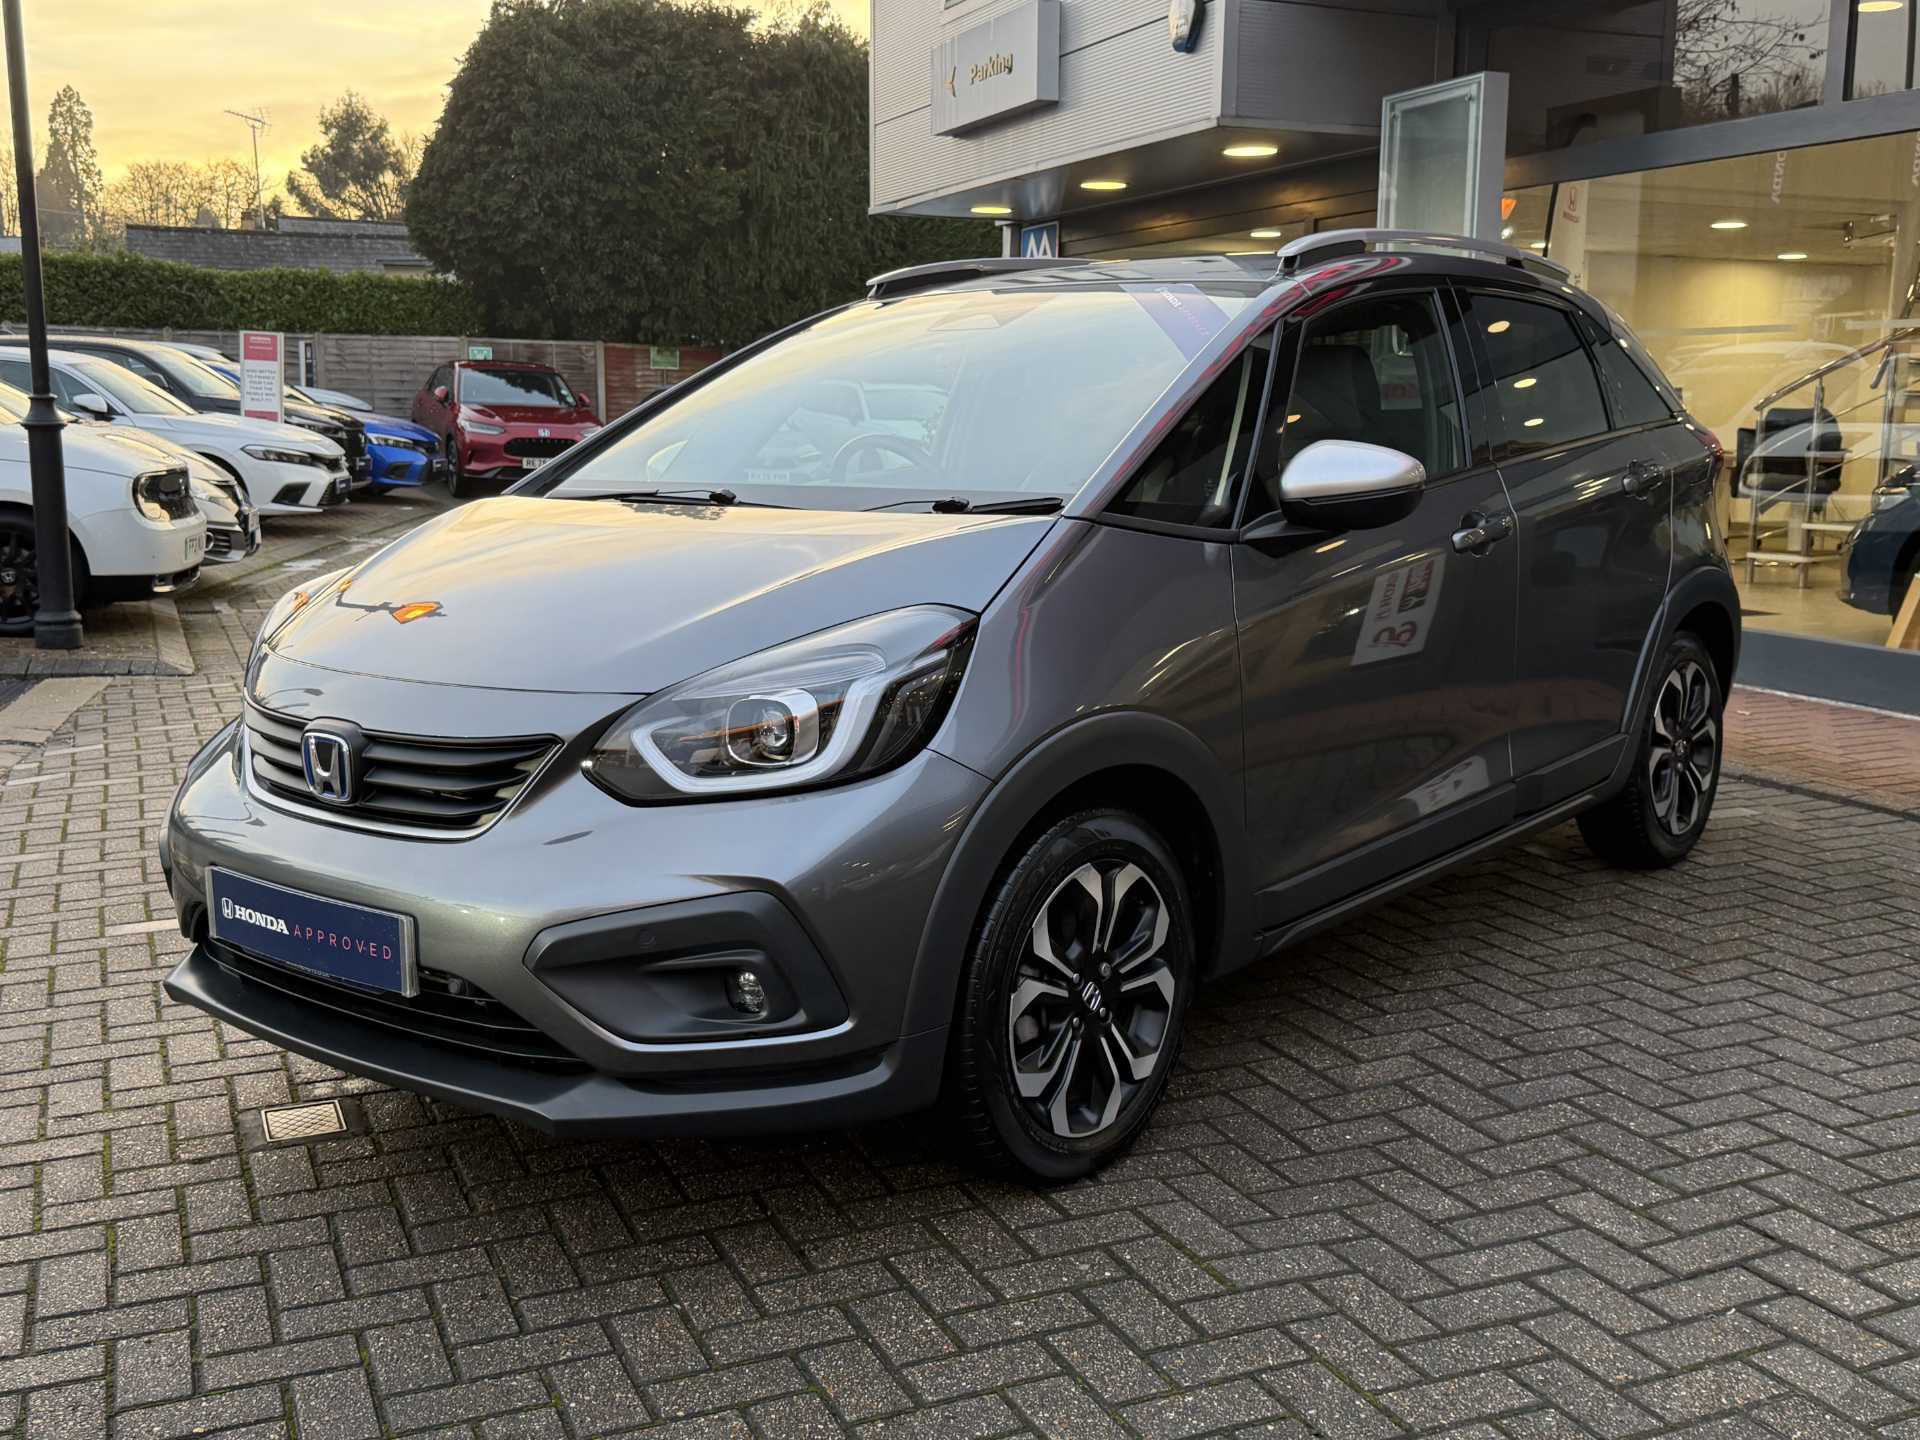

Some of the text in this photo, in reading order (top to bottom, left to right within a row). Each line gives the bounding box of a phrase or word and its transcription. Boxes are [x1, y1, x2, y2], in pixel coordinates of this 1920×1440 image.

[968, 53, 1014, 85] Parking
[234, 904, 290, 935] HONDA
[294, 924, 392, 960] APPROVED
